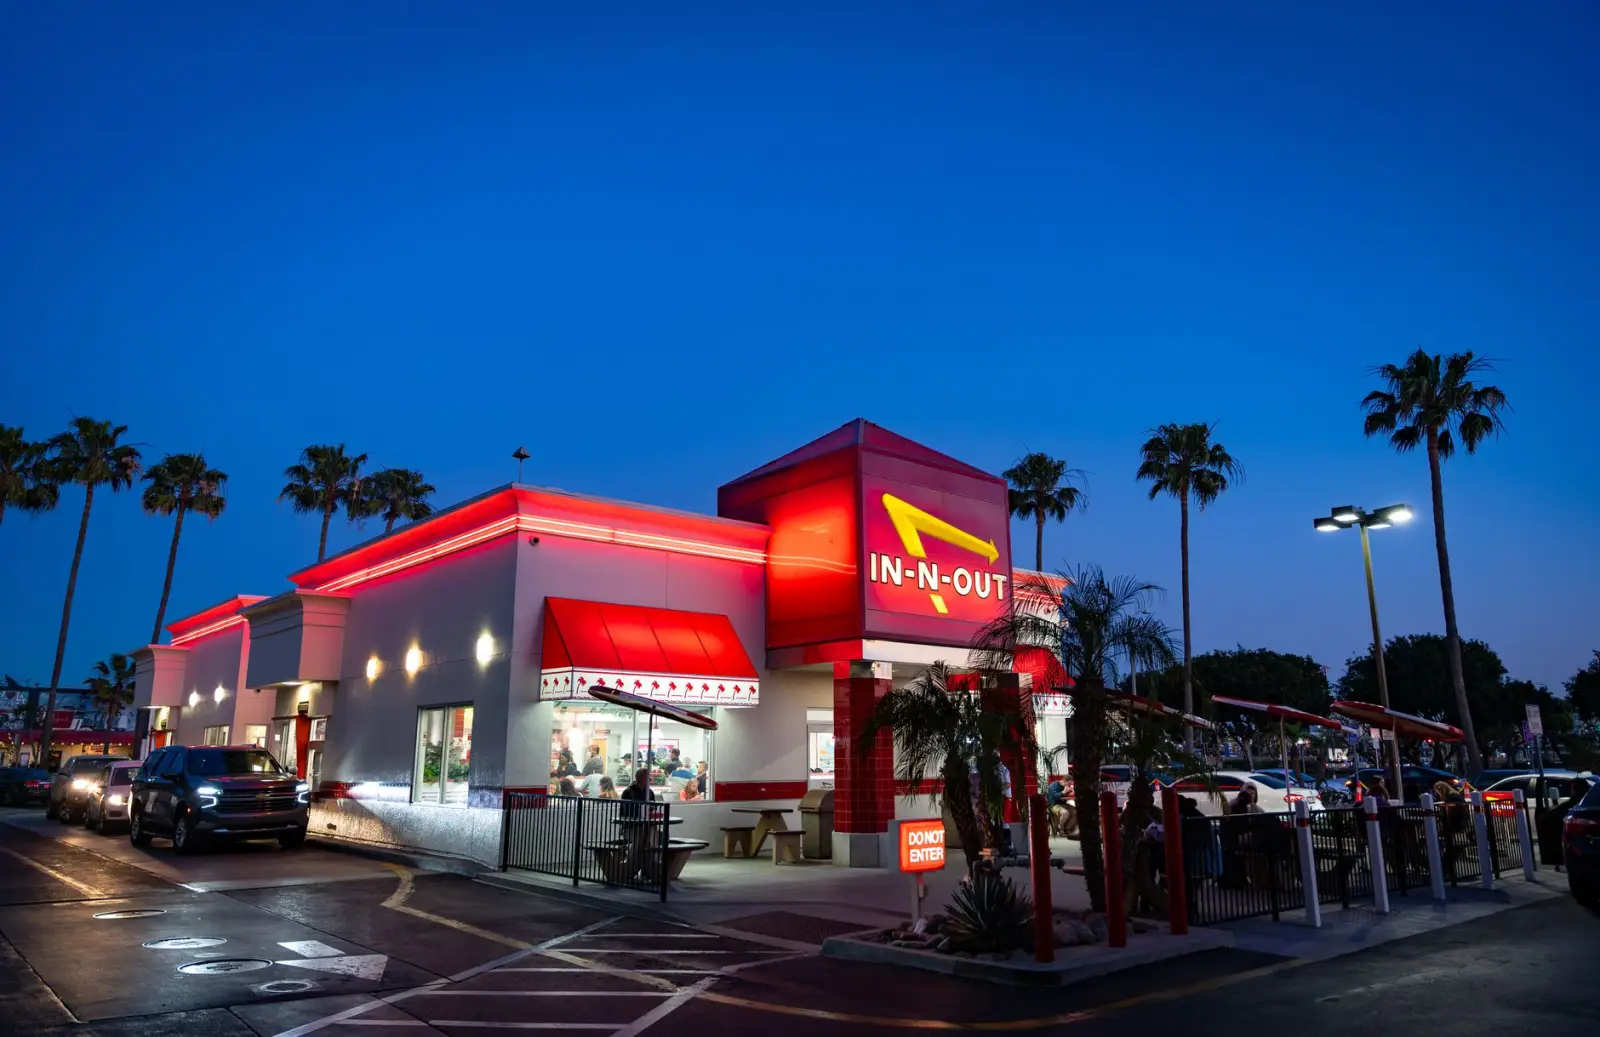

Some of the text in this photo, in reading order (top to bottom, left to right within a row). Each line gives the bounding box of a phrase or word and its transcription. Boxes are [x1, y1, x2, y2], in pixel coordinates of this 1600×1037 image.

[869, 552, 1008, 601] IN-N-OUT
[908, 829, 945, 846] DO NOT
[910, 847, 944, 863] ENTER
